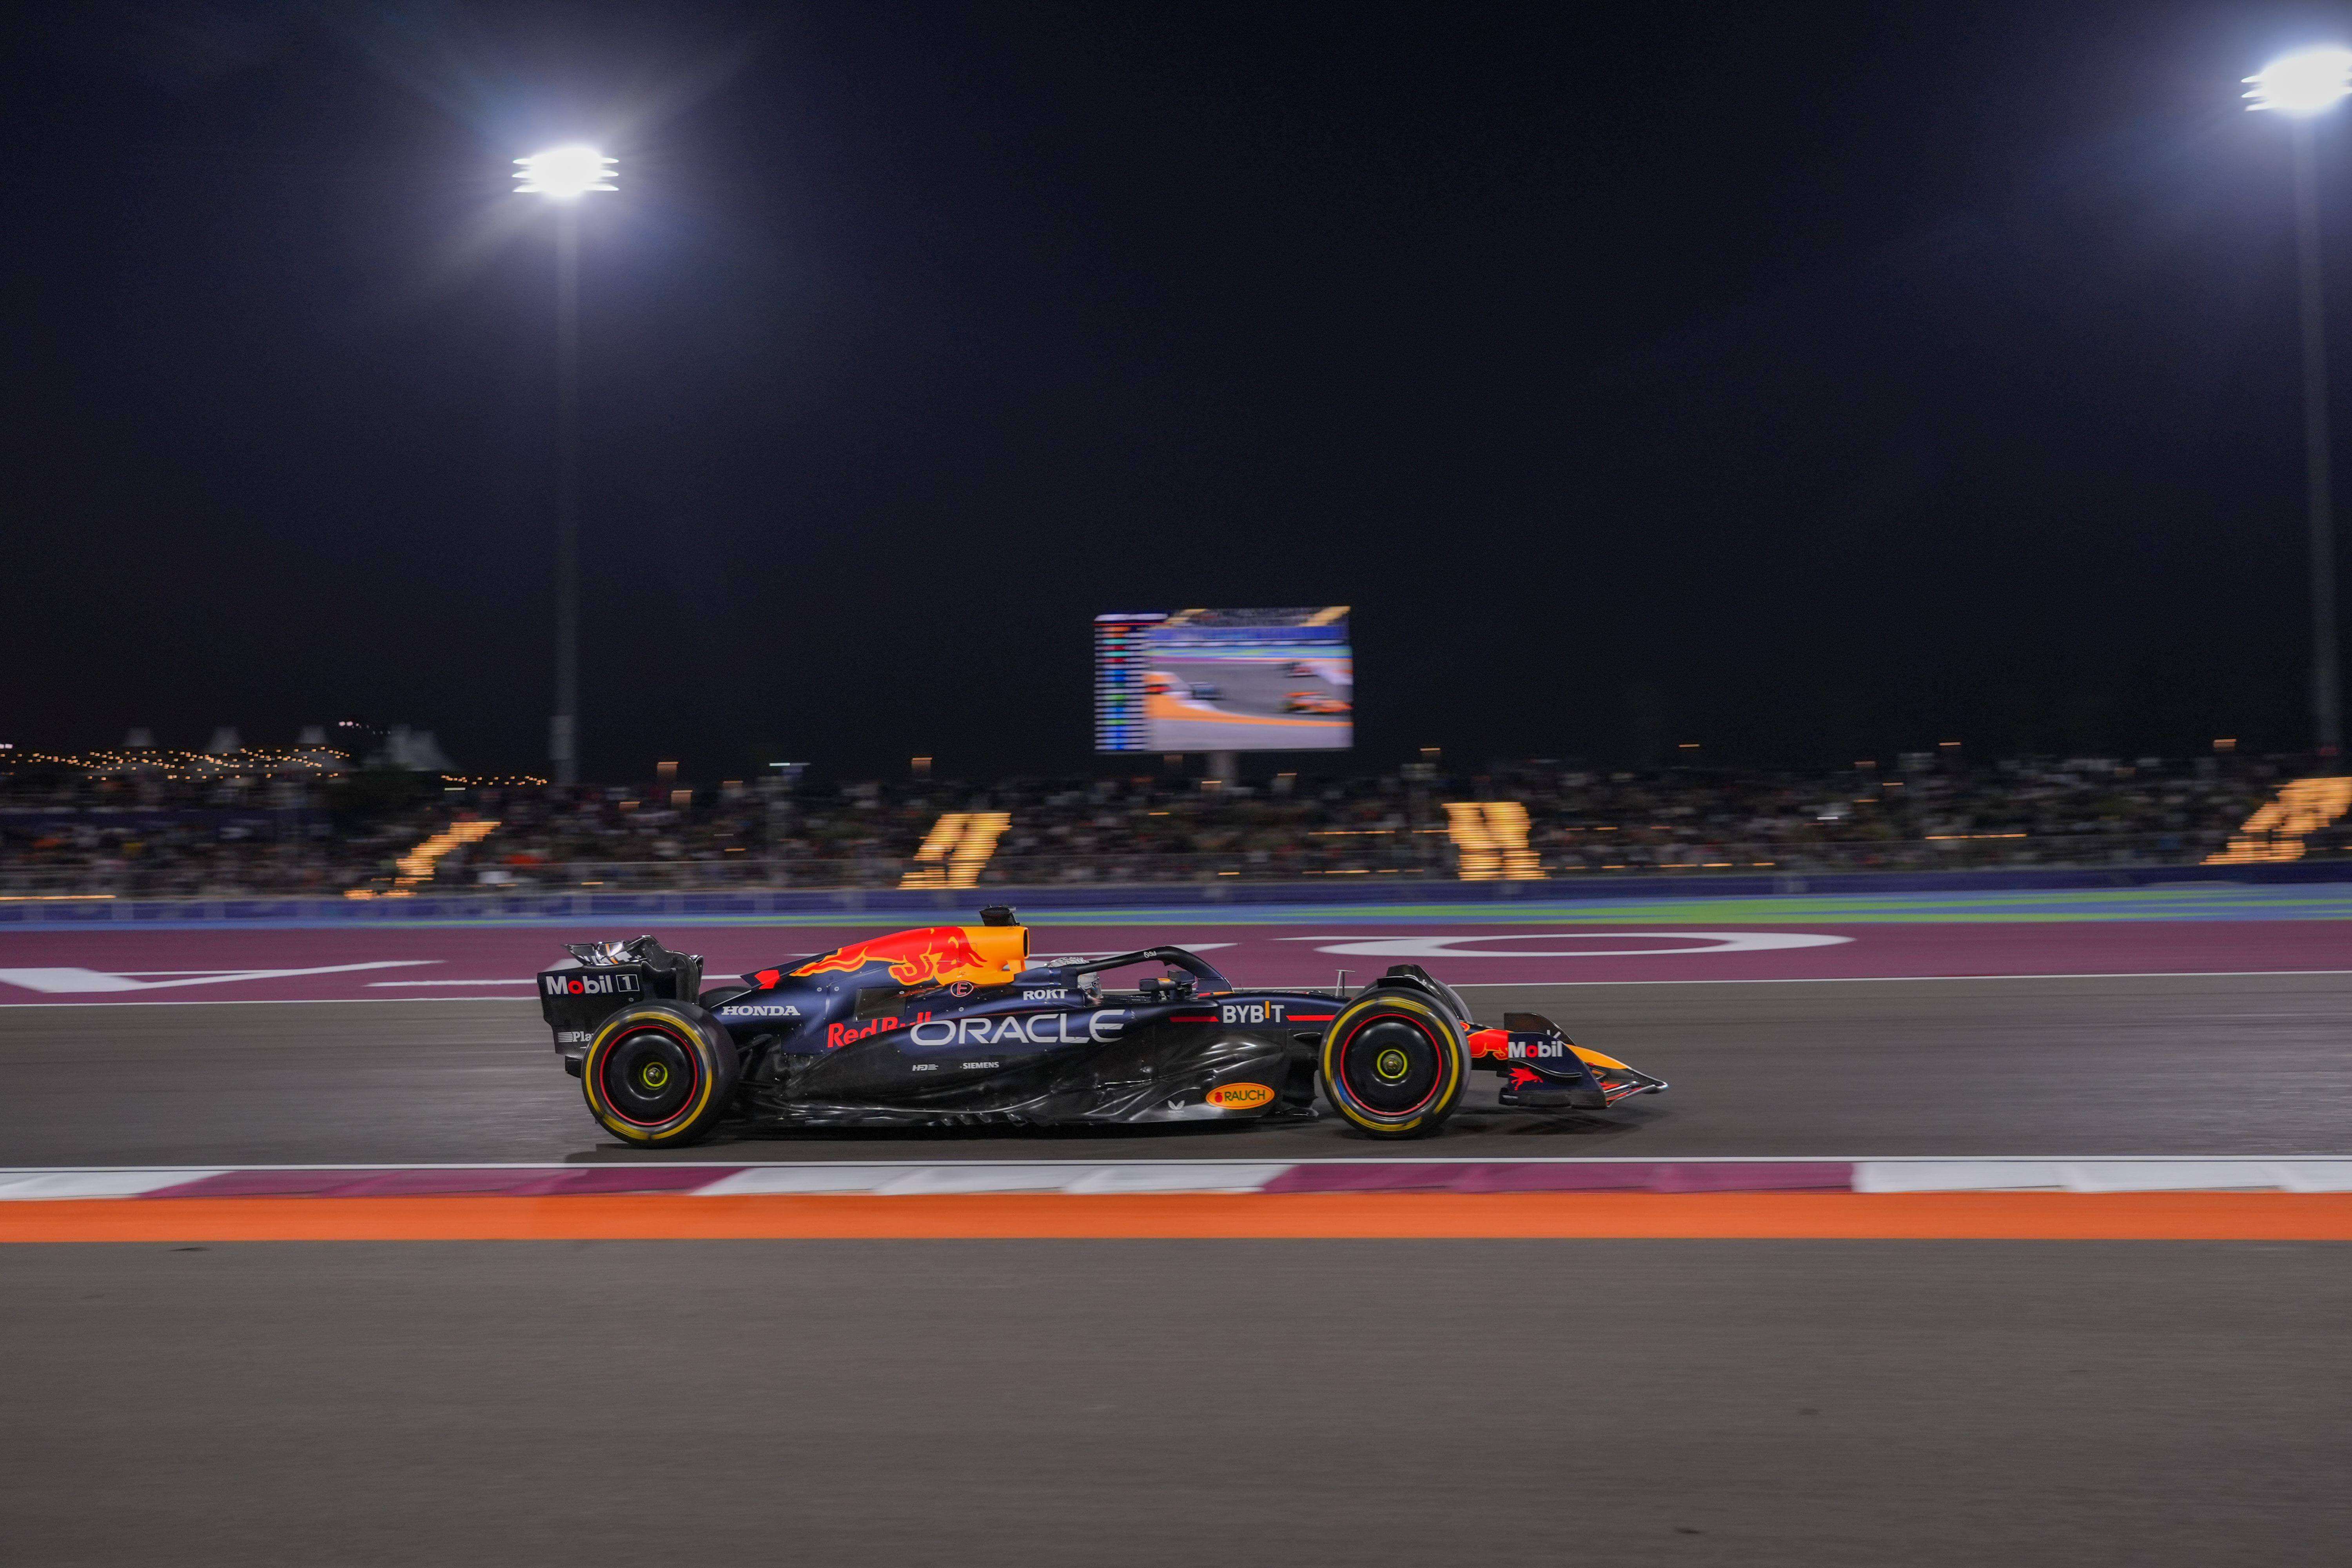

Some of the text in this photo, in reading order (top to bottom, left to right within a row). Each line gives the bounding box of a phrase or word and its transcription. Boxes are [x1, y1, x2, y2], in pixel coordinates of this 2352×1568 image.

[546, 975, 613, 995] Mobil
[1023, 989, 1069, 1000] ROKT
[721, 1005, 801, 1016] HONDA
[1223, 1001, 1285, 1024] BYBIT
[910, 1009, 1126, 1046] ORACLE
[572, 1031, 595, 1042] Pla
[1508, 1040, 1563, 1058] Mobil
[1224, 1089, 1266, 1102] RAUCH
